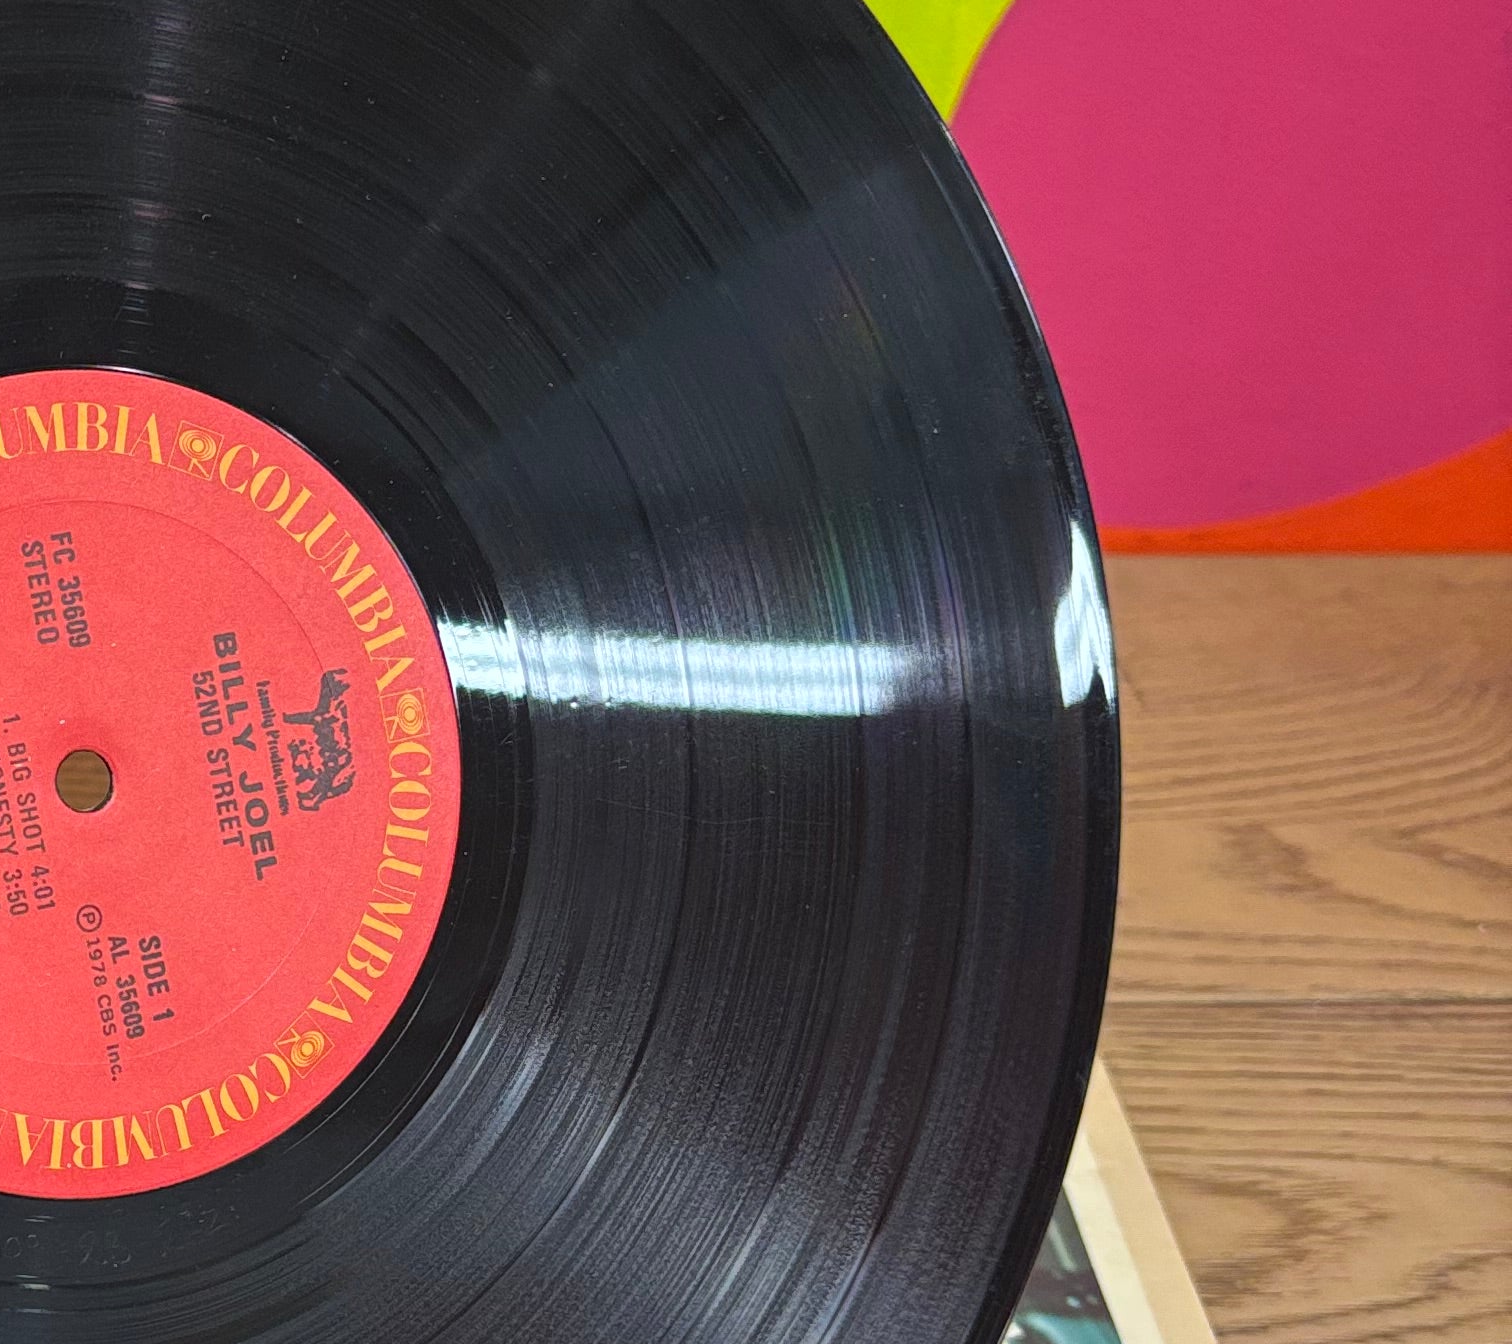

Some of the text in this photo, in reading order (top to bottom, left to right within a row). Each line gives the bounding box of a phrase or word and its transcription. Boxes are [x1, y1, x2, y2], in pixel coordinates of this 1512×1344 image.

[21, 540, 60, 645] STEREO
[50, 532, 91, 648] FC 35609
[219, 444, 415, 691] COLUMBIA
[193, 670, 244, 847] 52ND STREET
[213, 632, 278, 881] BILLY JOEL
[3, 714, 55, 910] 1. BIG SHOT 4:01
[3, 869, 29, 916] 3:50
[309, 741, 432, 1024] COLUMBIA
[85, 937, 107, 988] 1978
[96, 994, 117, 1037] CBS
[108, 935, 145, 1040] AL 35609
[138, 935, 175, 1023] SIDE 1
[12, 1053, 291, 1170] COLUMBIA
[106, 1041, 123, 1082] Inc.
